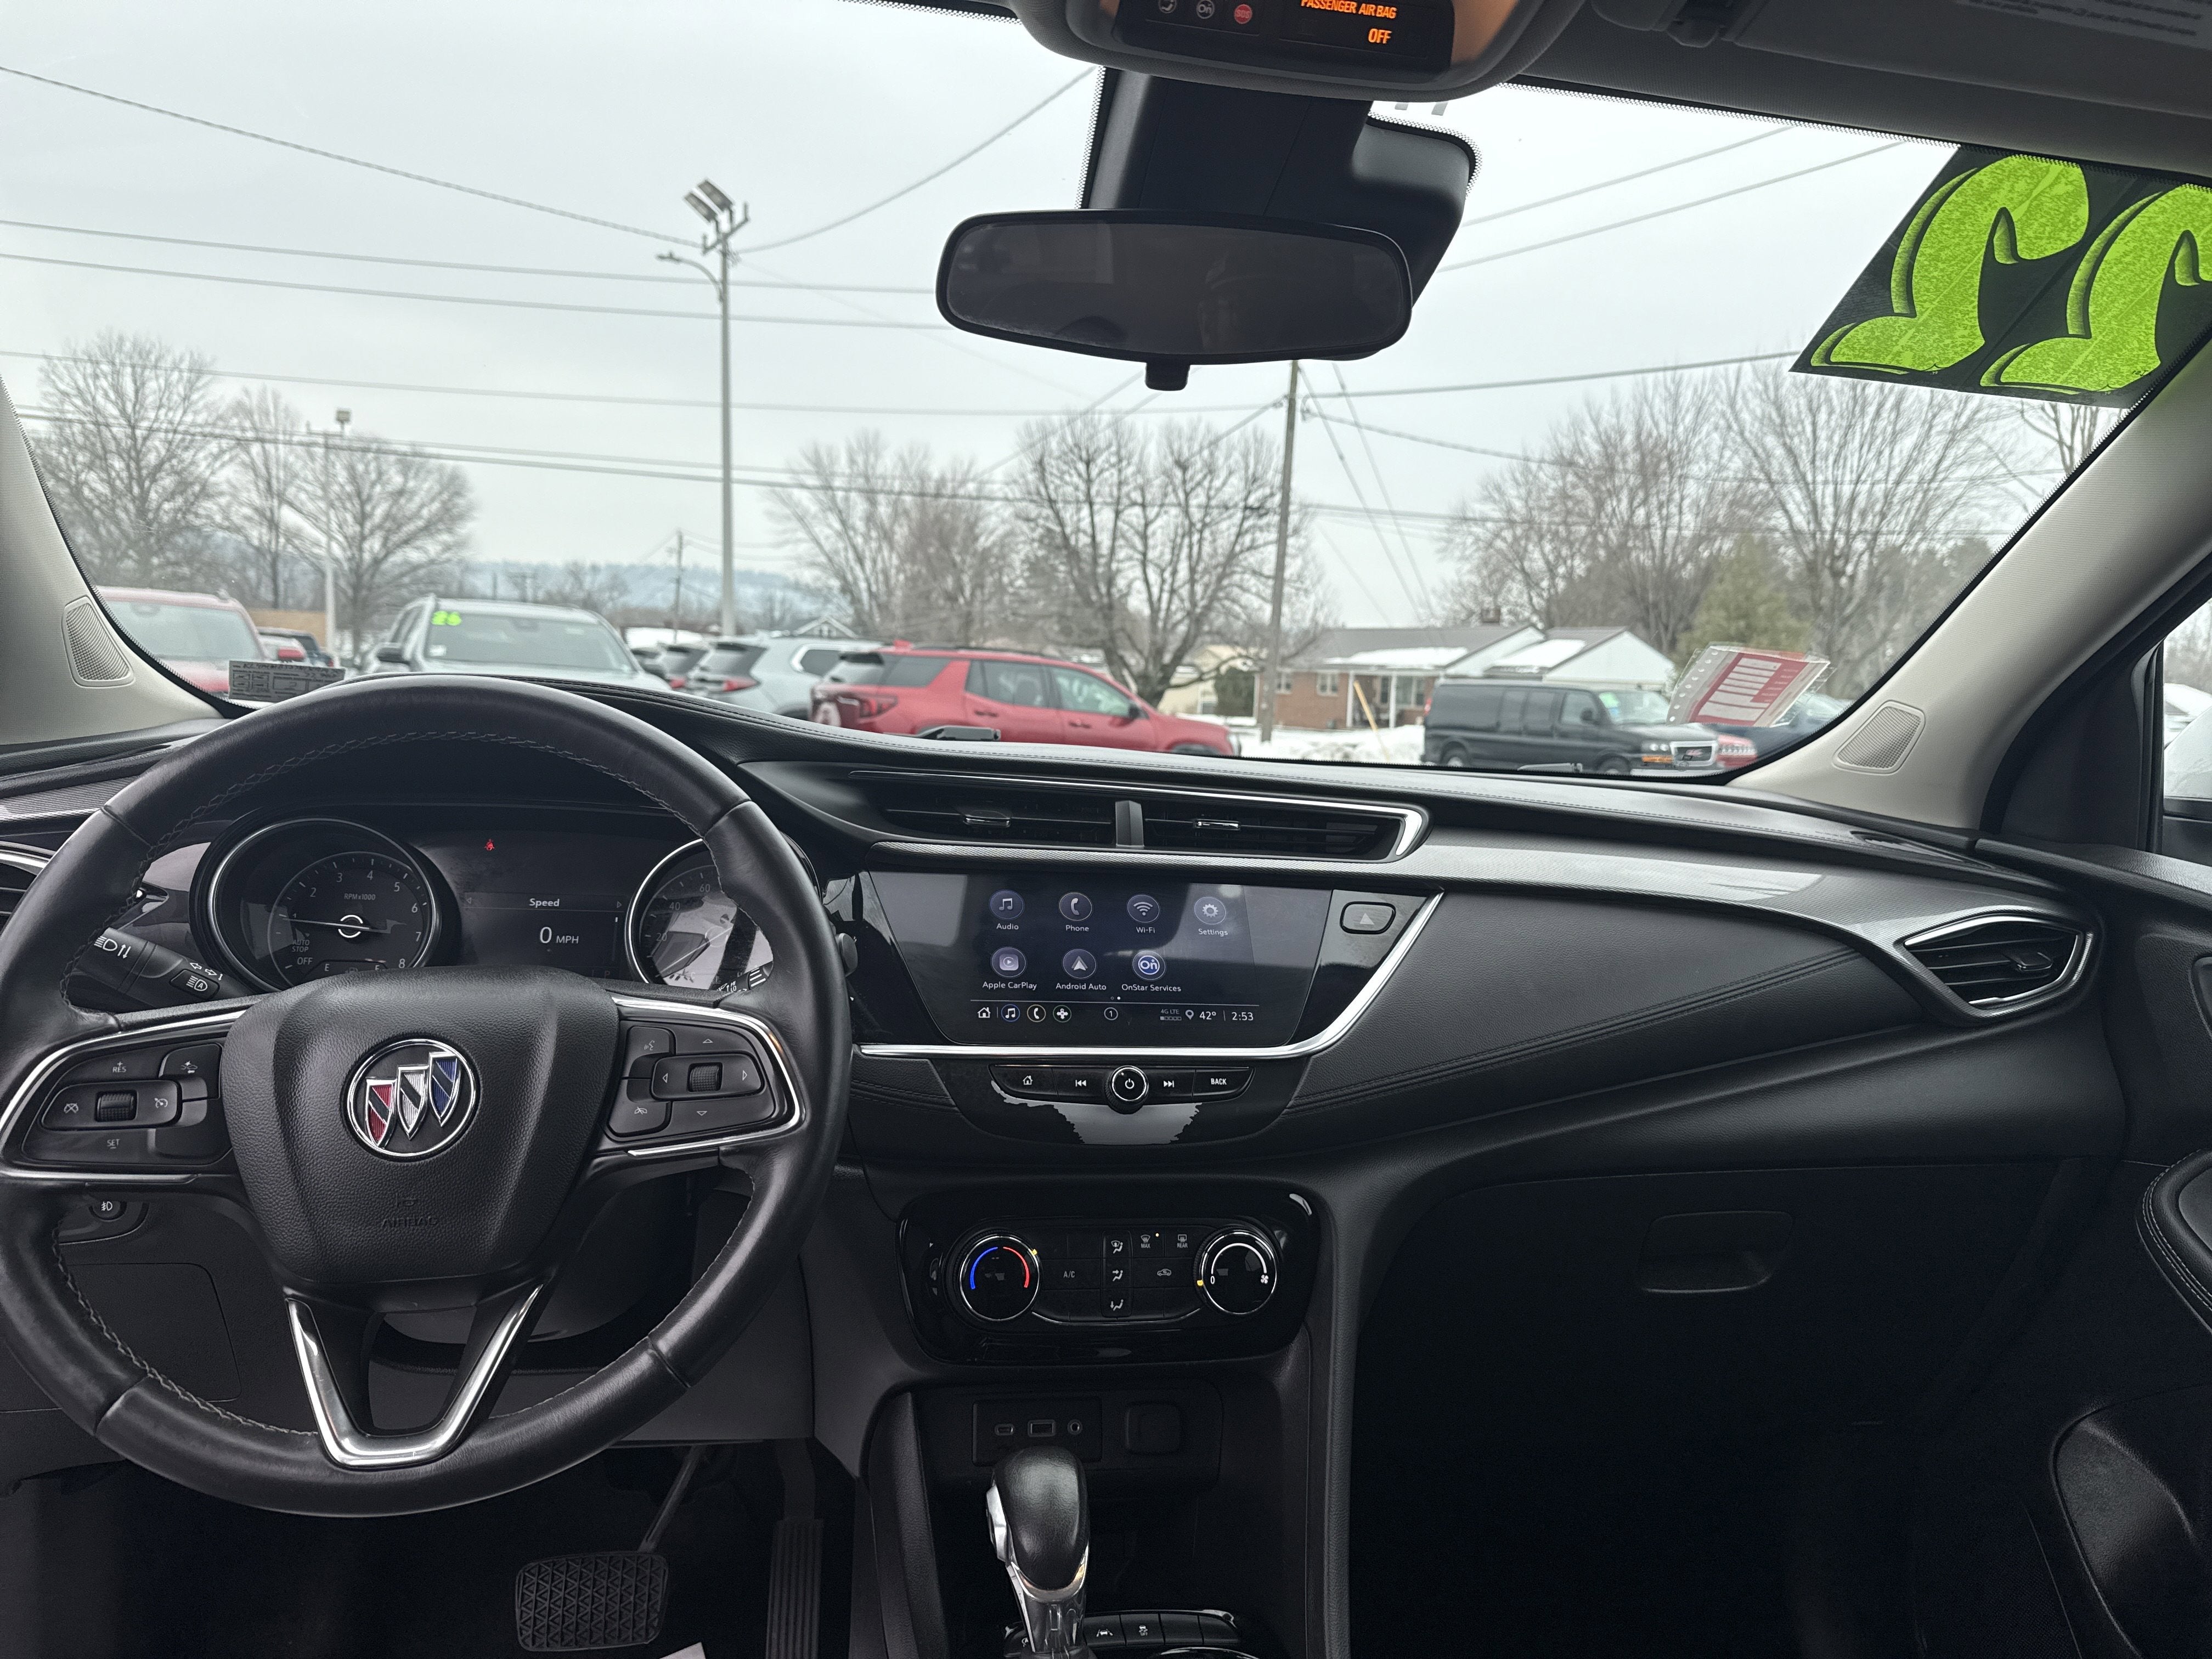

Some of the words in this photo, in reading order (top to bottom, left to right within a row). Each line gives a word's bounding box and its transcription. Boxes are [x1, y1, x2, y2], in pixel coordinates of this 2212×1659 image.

[1301, 0, 1357, 14] PASSENGER
[1236, 9, 1251, 19] SOS
[1368, 28, 1392, 44] OFF
[336, 873, 342, 883] 3
[367, 870, 373, 880] 4
[394, 882, 400, 892] 5
[699, 884, 710, 892] 60
[310, 887, 317, 898] 2
[411, 902, 417, 913] 6
[529, 898, 560, 908] Speed
[669, 902, 680, 911] 40
[416, 932, 421, 941] 7
[540, 926, 552, 944] 0
[556, 935, 579, 944] MPH
[656, 933, 667, 941] 20
[1198, 928, 1228, 937] Settings
[297, 957, 313, 965] OFF
[399, 958, 405, 968] 8
[325, 963, 329, 972] E
[982, 981, 1006, 990] Apple
[1008, 982, 1037, 991] CarPlay
[1232, 1012, 1254, 1021] 2:53
[107, 1138, 120, 1147] SET
